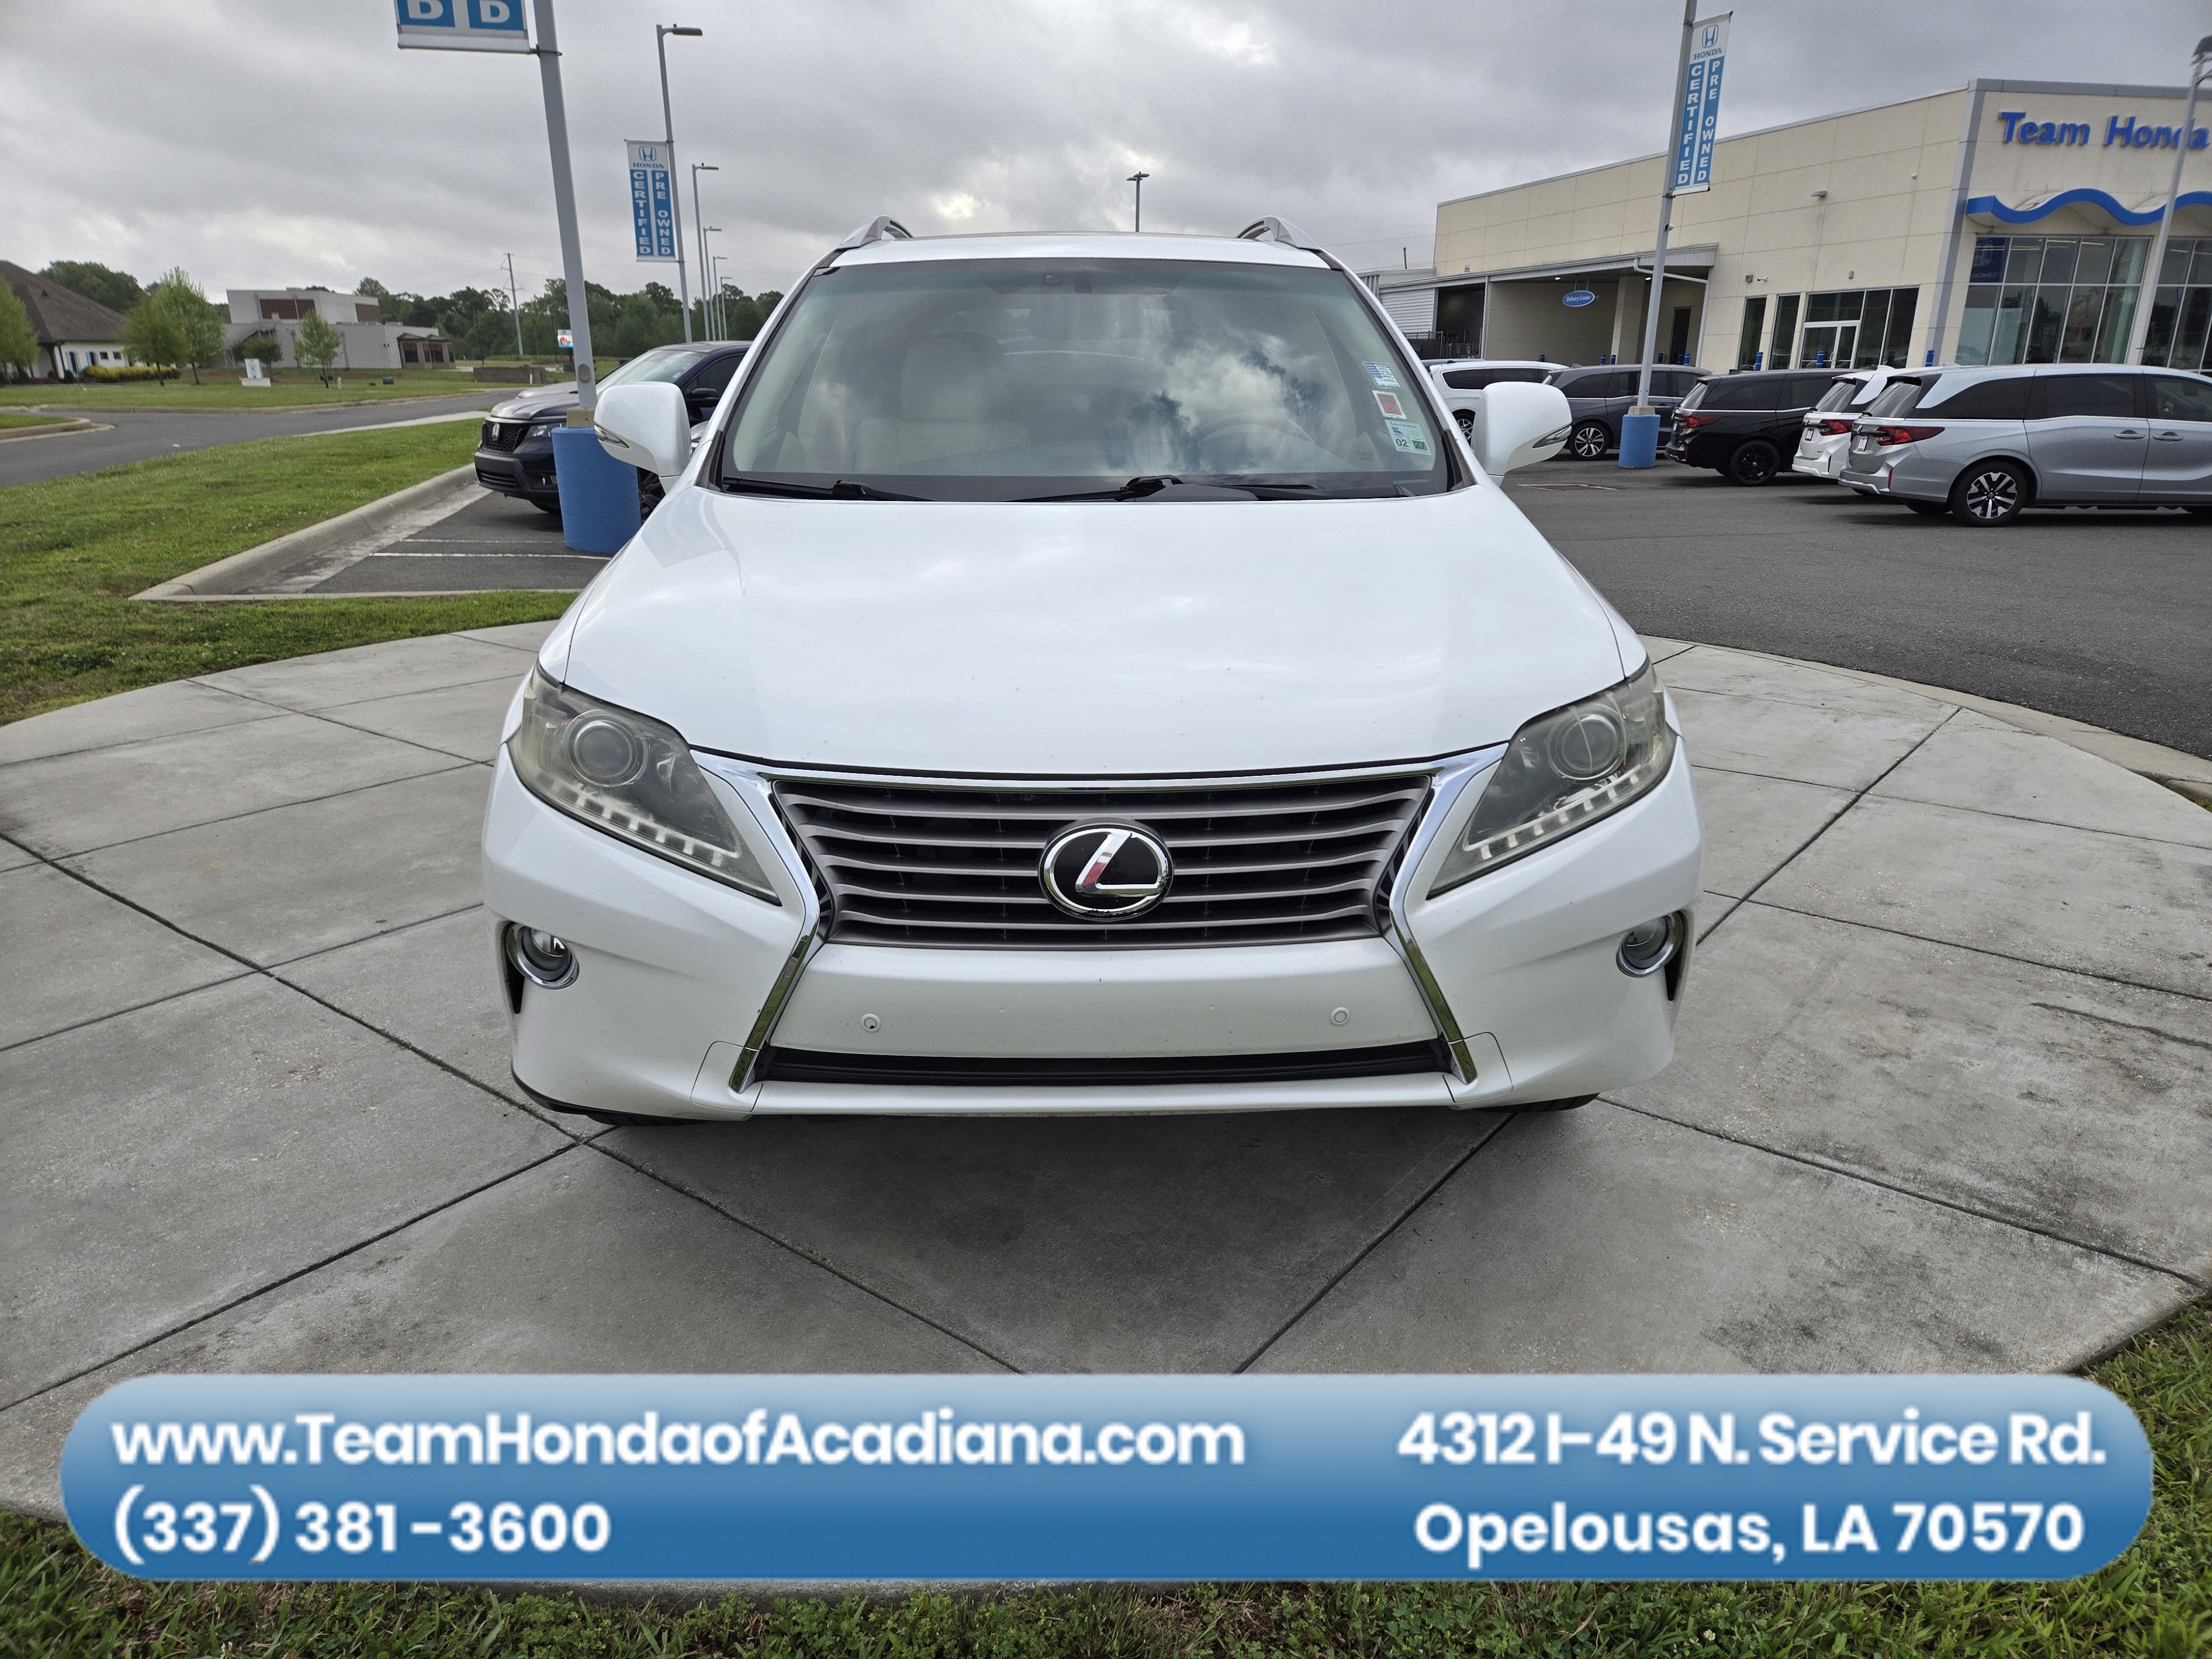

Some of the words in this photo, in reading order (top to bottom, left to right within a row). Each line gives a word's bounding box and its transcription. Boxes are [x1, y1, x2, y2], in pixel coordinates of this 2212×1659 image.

[1693, 48, 1723, 60] HONDA
[1709, 60, 1720, 100] PRE
[1677, 65, 1702, 184] CERTIFIED
[1999, 112, 2091, 145] Team
[1697, 115, 1714, 181] OWNED
[655, 172, 666, 200] PRE
[633, 171, 651, 254] CERTIFIED
[657, 210, 671, 255] OWNED
[1396, 438, 1409, 447] 02
[1415, 441, 1426, 450] 27
